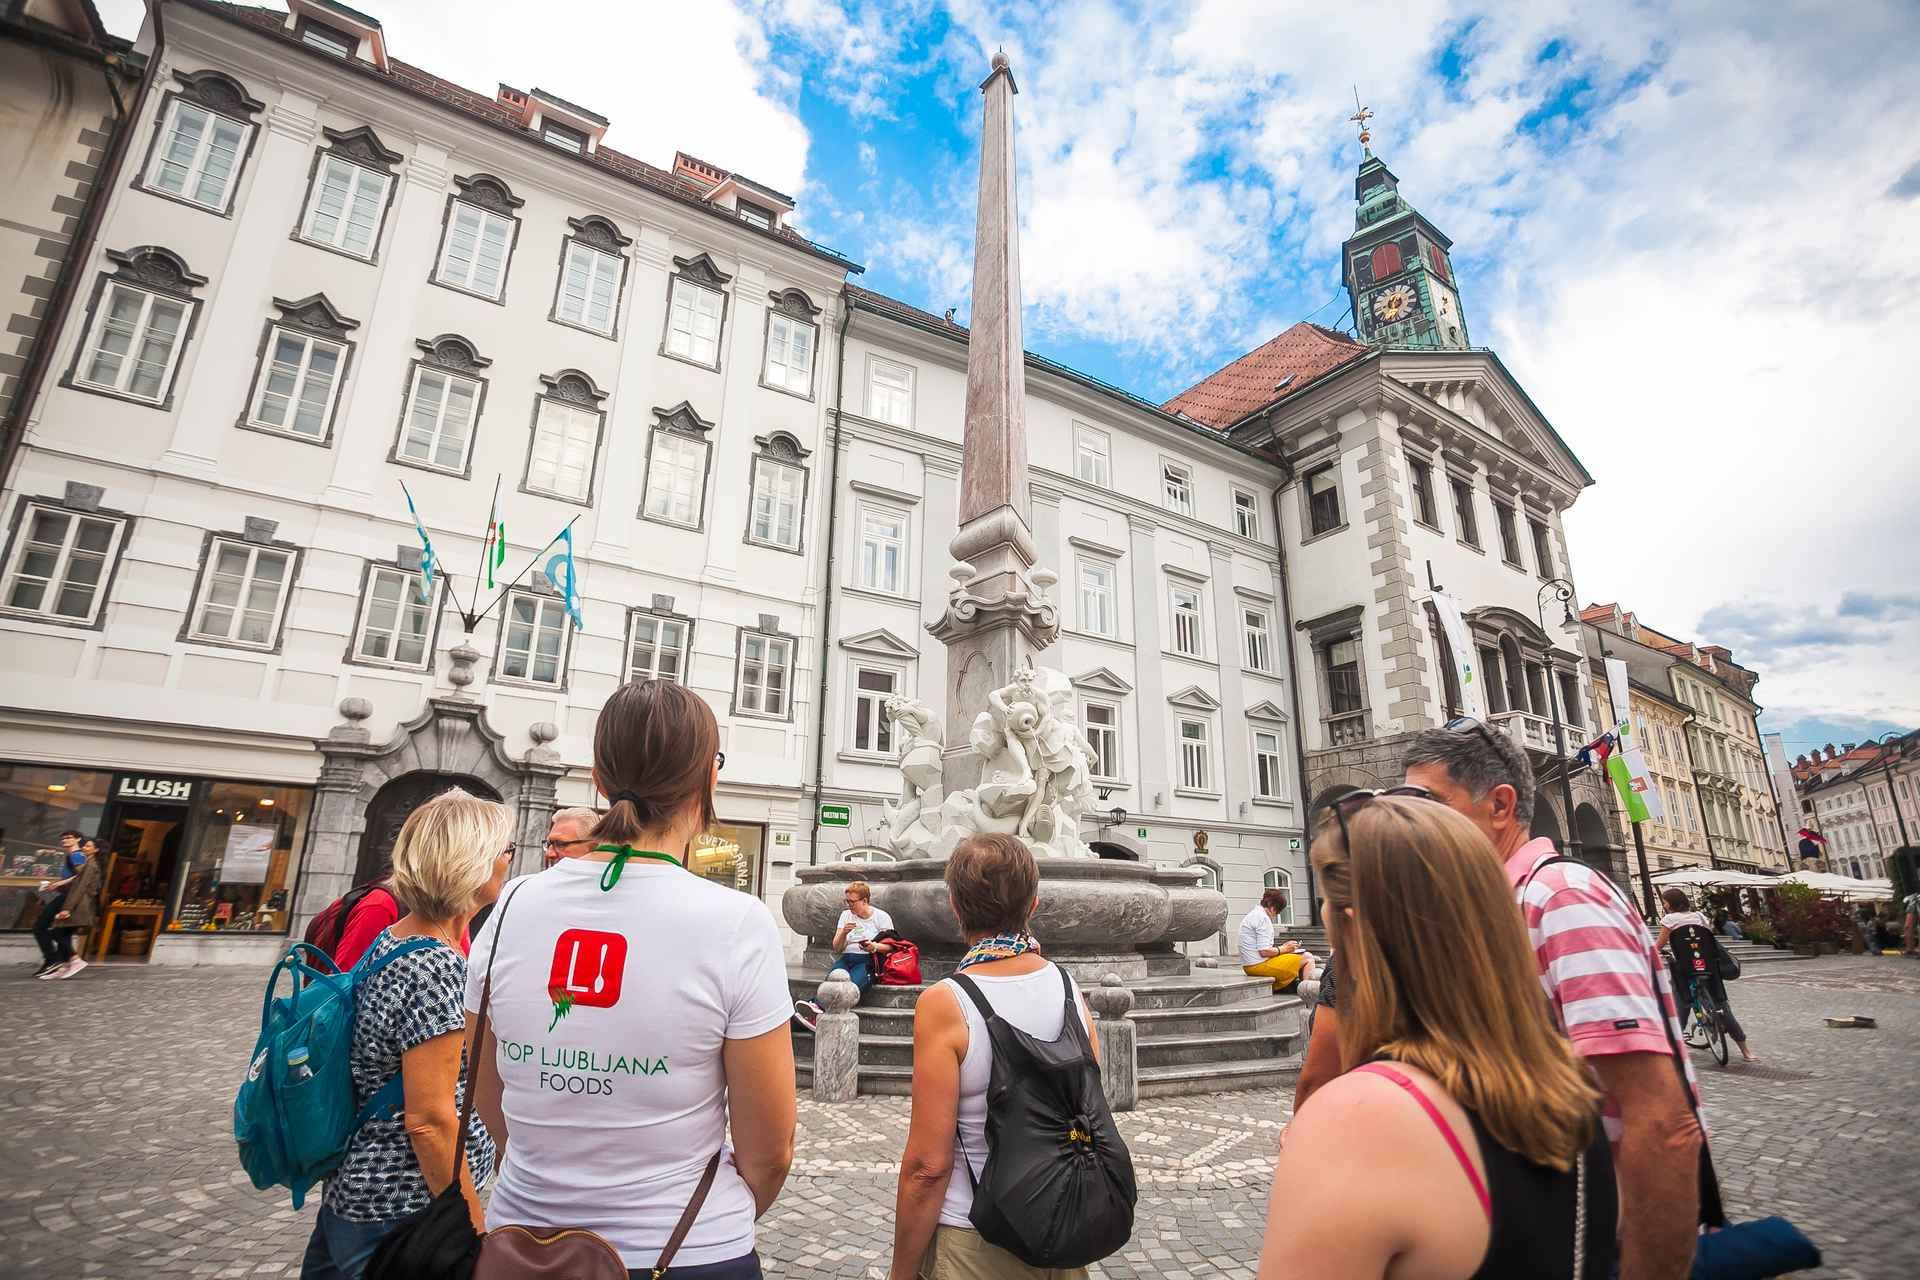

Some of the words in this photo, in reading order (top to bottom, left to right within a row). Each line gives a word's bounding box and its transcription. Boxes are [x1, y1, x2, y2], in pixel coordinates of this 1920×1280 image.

[118, 777, 192, 798] LUSH
[501, 1039, 534, 1063] TOP
[540, 1046, 669, 1076] LJUBLJANA
[540, 1071, 614, 1096] FOODS
